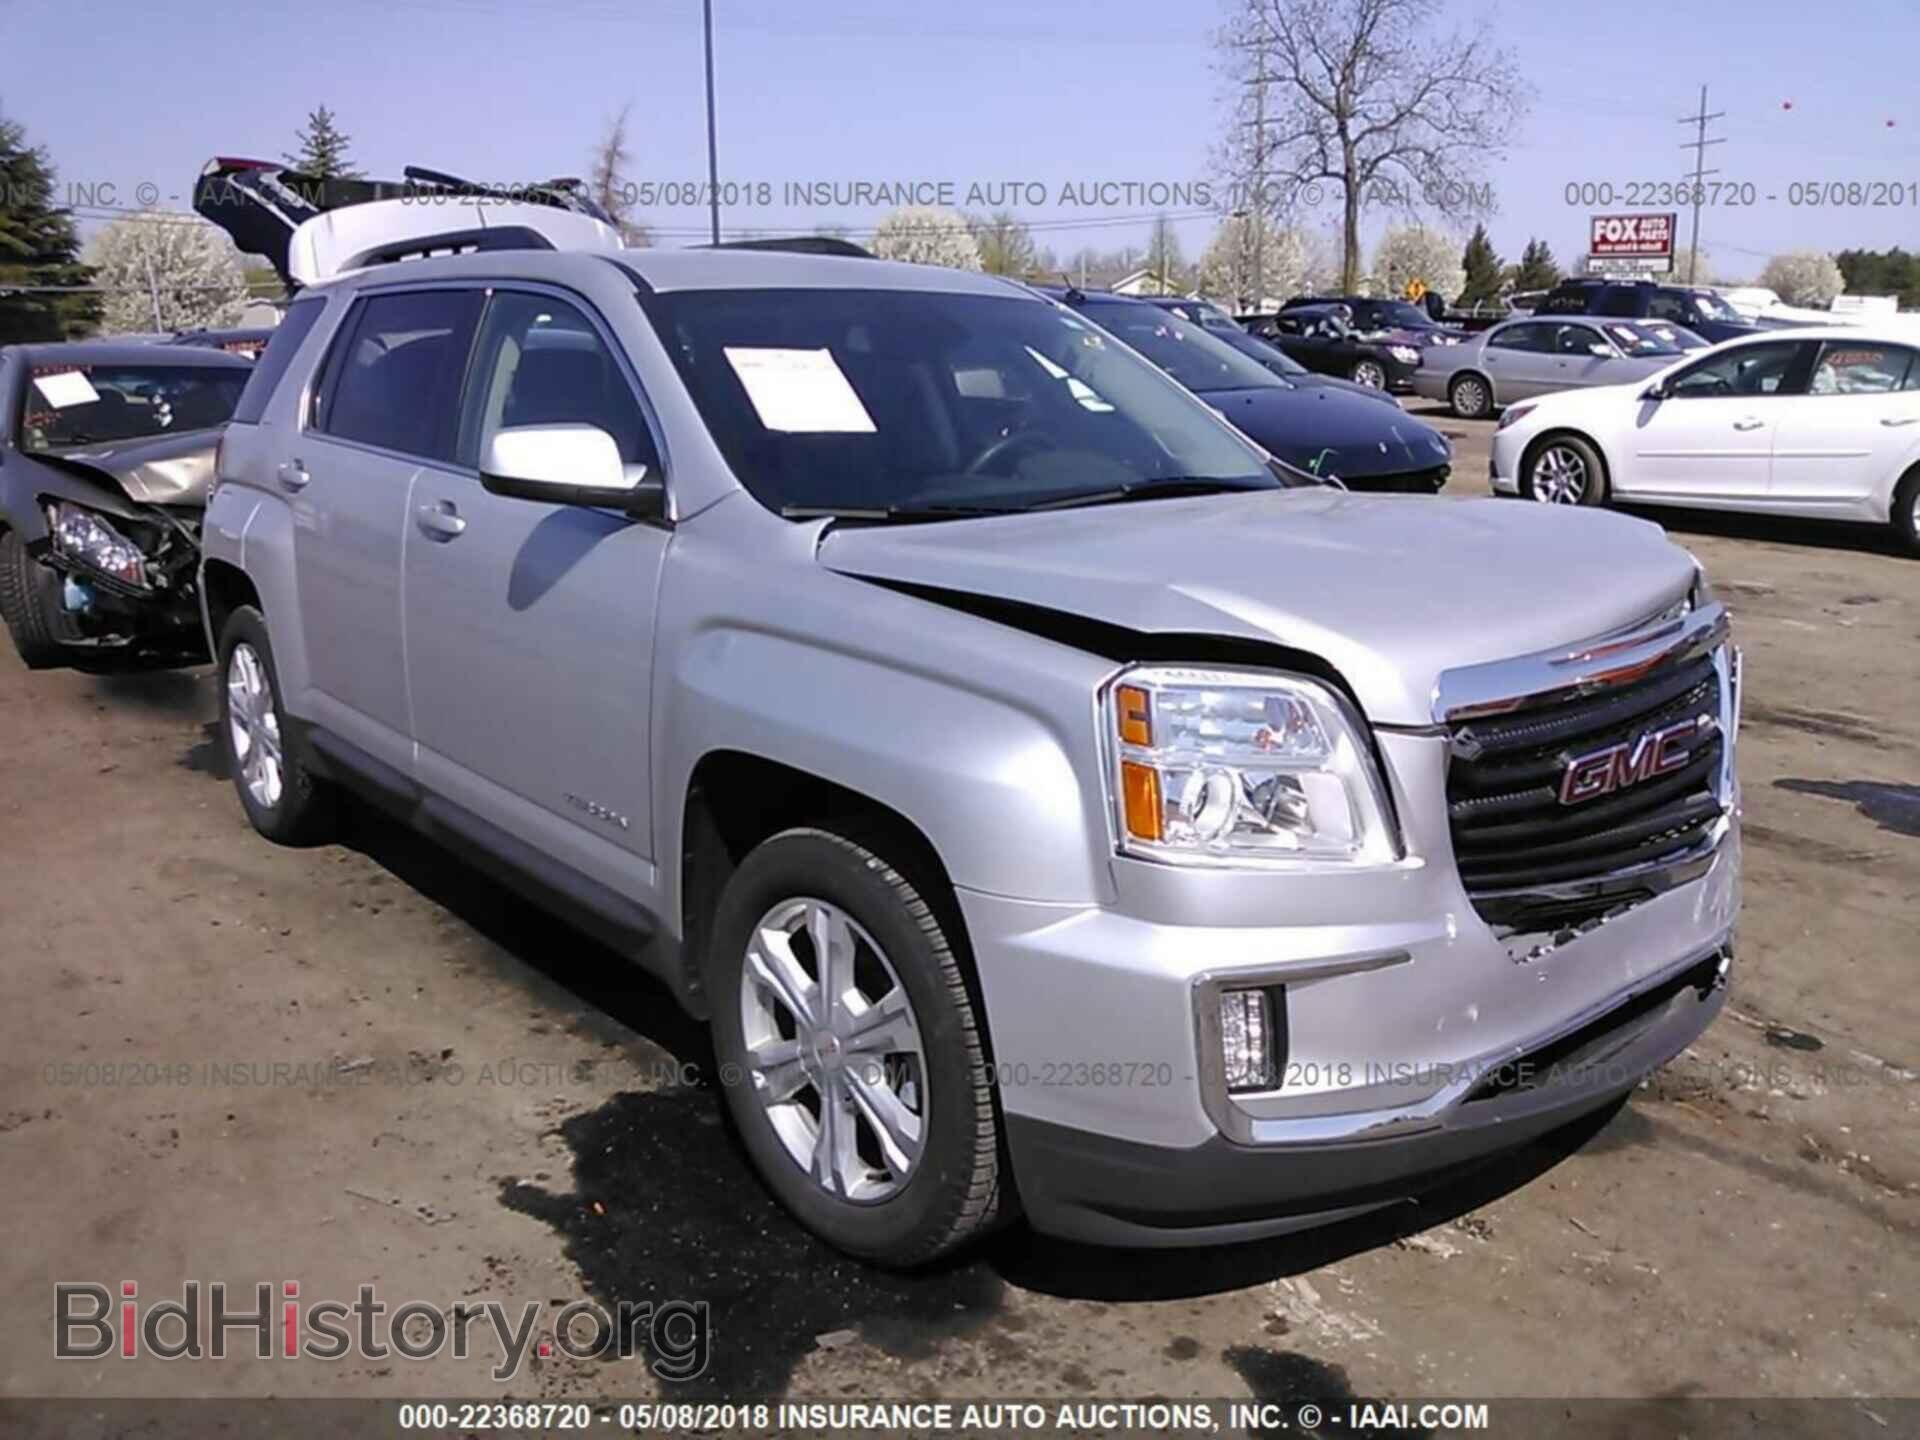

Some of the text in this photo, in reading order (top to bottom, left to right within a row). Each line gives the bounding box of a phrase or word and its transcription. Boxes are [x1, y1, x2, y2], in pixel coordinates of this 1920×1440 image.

[1594, 218, 1667, 242] FOX AUTO
[1639, 229, 1669, 241] PARTS
[1560, 719, 1697, 806] GMC
